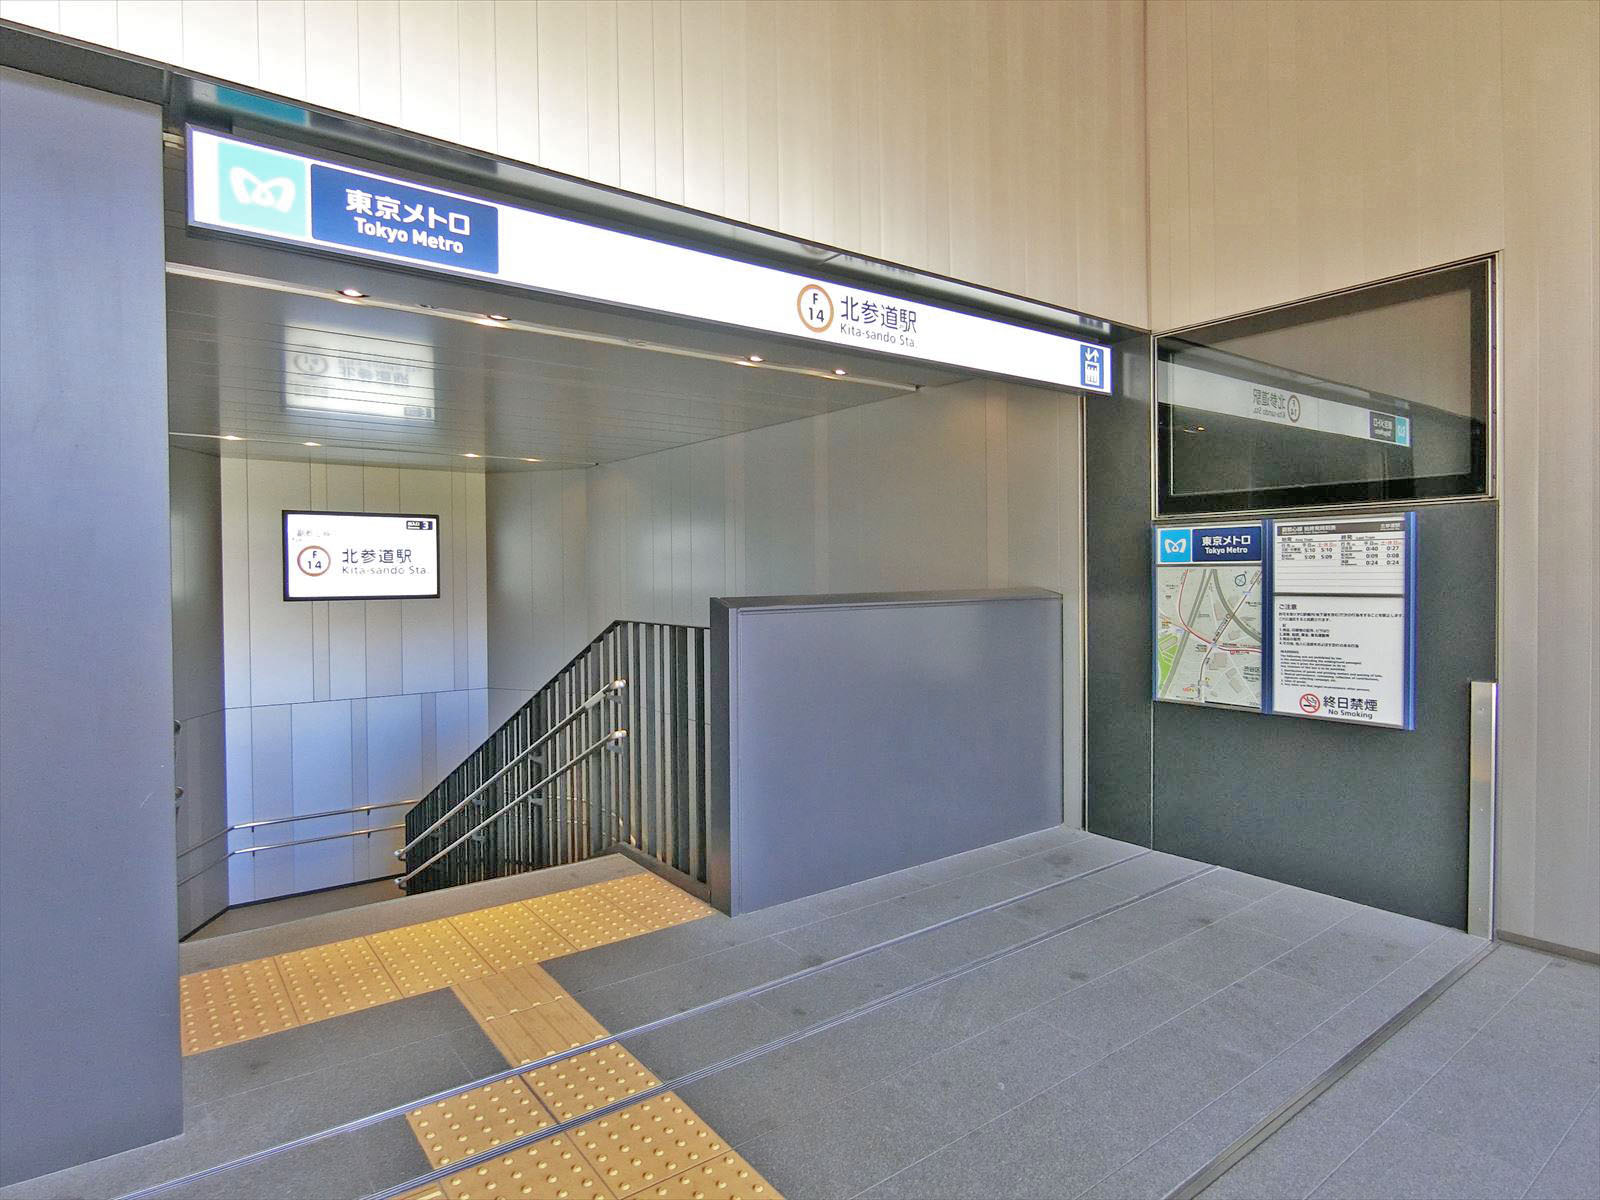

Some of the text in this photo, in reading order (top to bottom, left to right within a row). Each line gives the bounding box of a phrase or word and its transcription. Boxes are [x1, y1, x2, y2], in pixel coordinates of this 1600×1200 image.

[345, 188, 471, 236] 東京メトロ
[353, 216, 464, 254] Tokyo Metro
[812, 292, 819, 305] F
[808, 307, 825, 323] 14
[840, 295, 918, 334] 北参道駅
[840, 323, 896, 344] Kita-sando
[422, 520, 430, 530] 3
[1201, 535, 1251, 547] 東京メトロ
[312, 550, 318, 559] F
[342, 548, 412, 564] 北参道駅
[1204, 546, 1248, 555] Tokyo Metro
[307, 560, 322, 570] 14
[342, 565, 405, 575] Kita-sando
[1323, 695, 1378, 712] 終日禁煙
[1328, 708, 1373, 720] No Smoking
